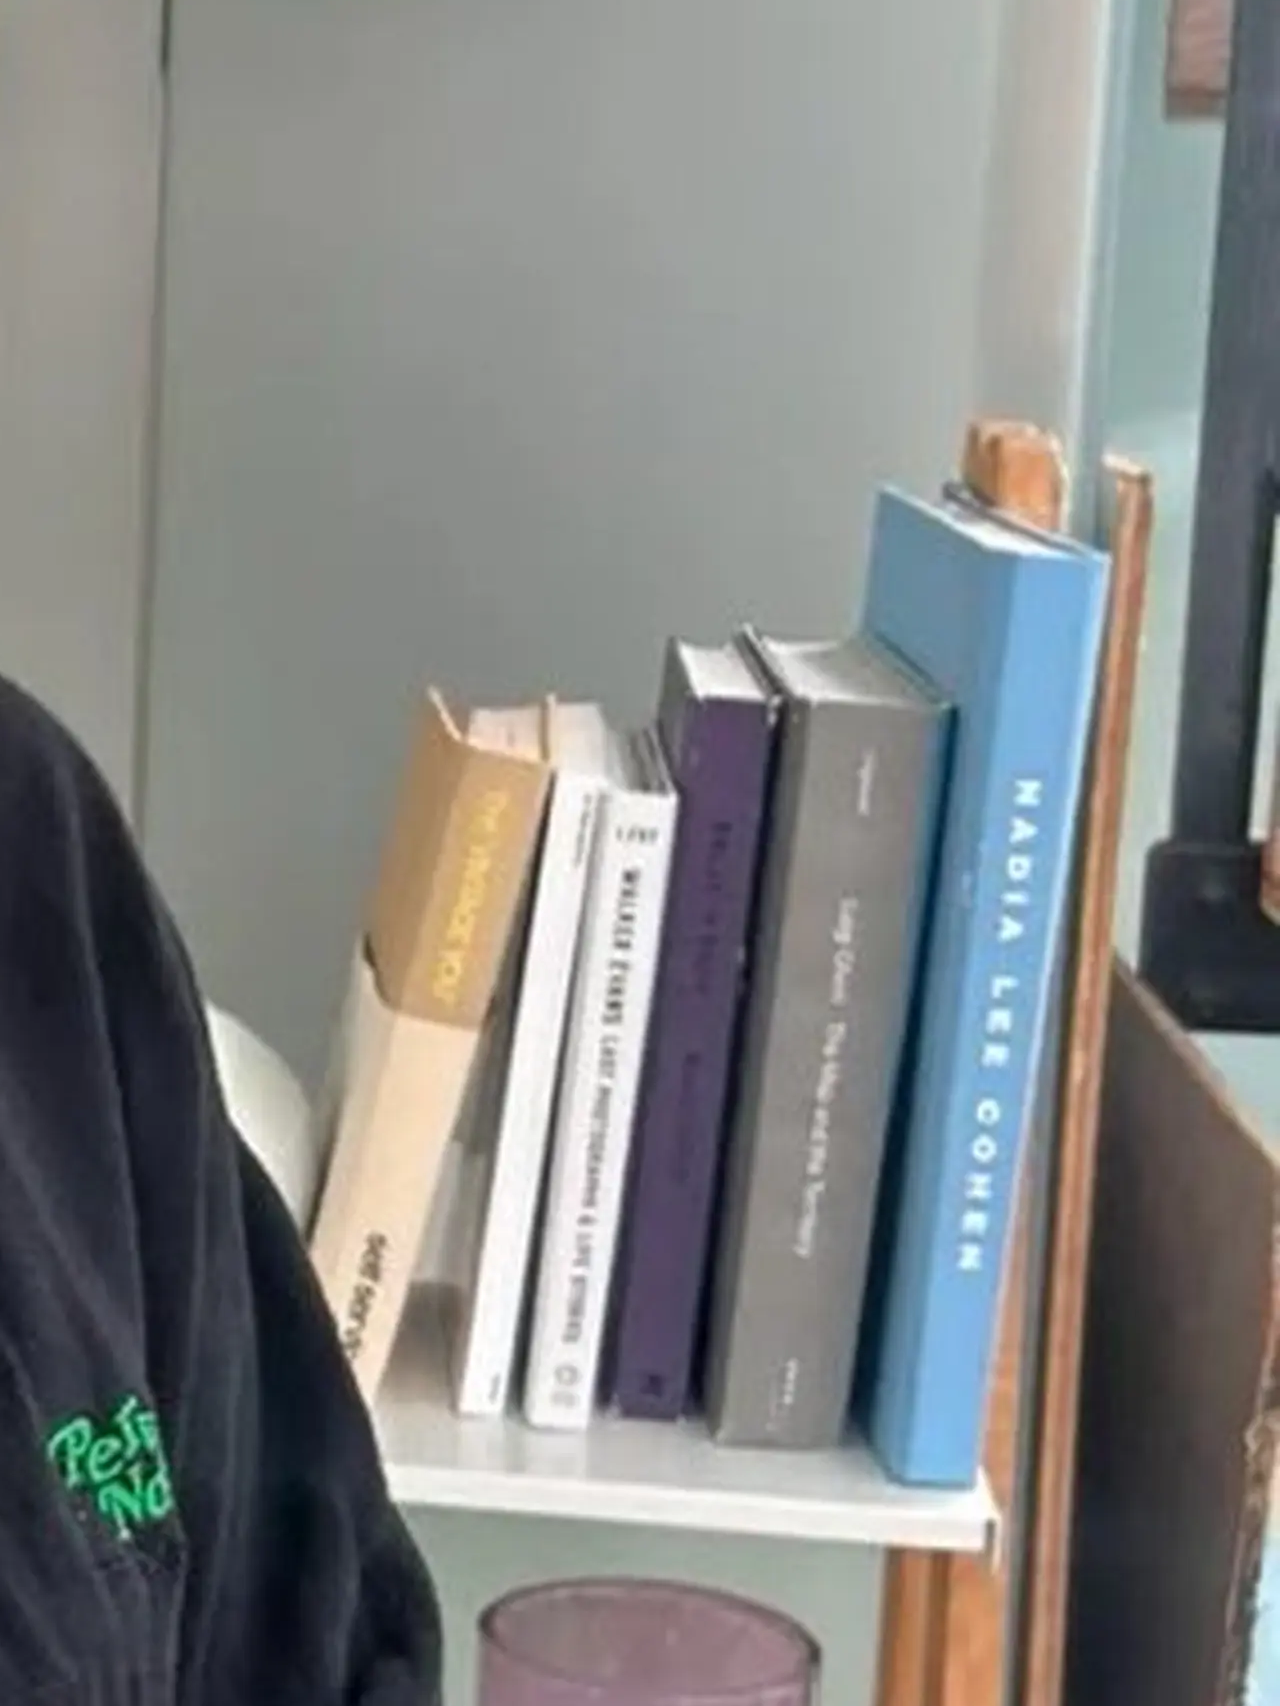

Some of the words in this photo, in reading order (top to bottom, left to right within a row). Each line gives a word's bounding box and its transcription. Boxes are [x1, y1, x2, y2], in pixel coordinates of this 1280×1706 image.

[994, 777, 1042, 942] NADIA
[980, 974, 1020, 1069] LEE
[956, 1097, 1001, 1273] COHEN
